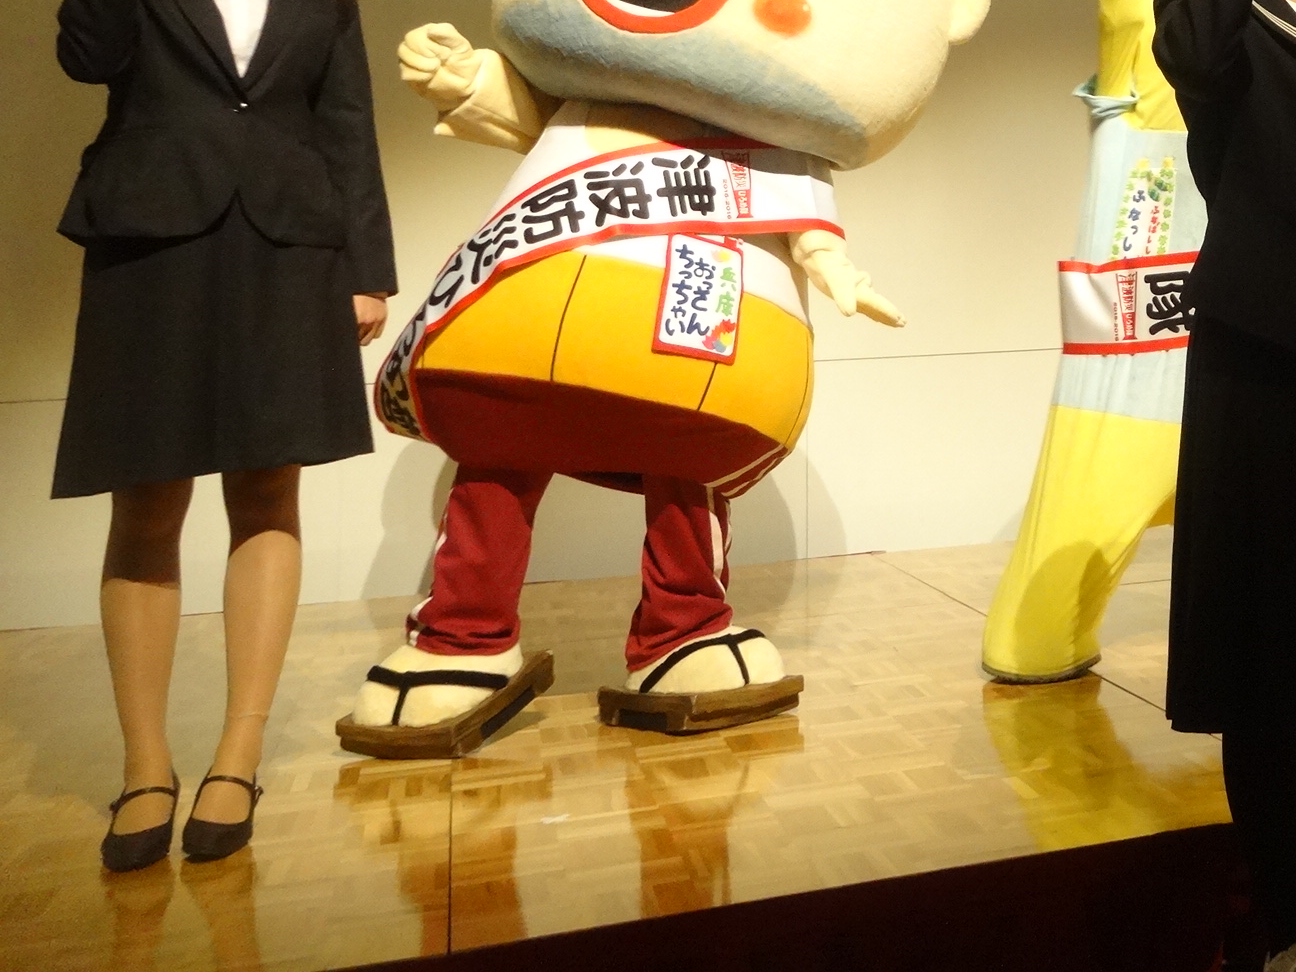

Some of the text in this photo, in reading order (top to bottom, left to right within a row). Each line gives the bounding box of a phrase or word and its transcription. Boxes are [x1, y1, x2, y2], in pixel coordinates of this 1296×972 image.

[1122, 189, 1146, 259] ふなっし
[1143, 205, 1160, 256] ふなばしし
[665, 243, 694, 337] ちっちゃい
